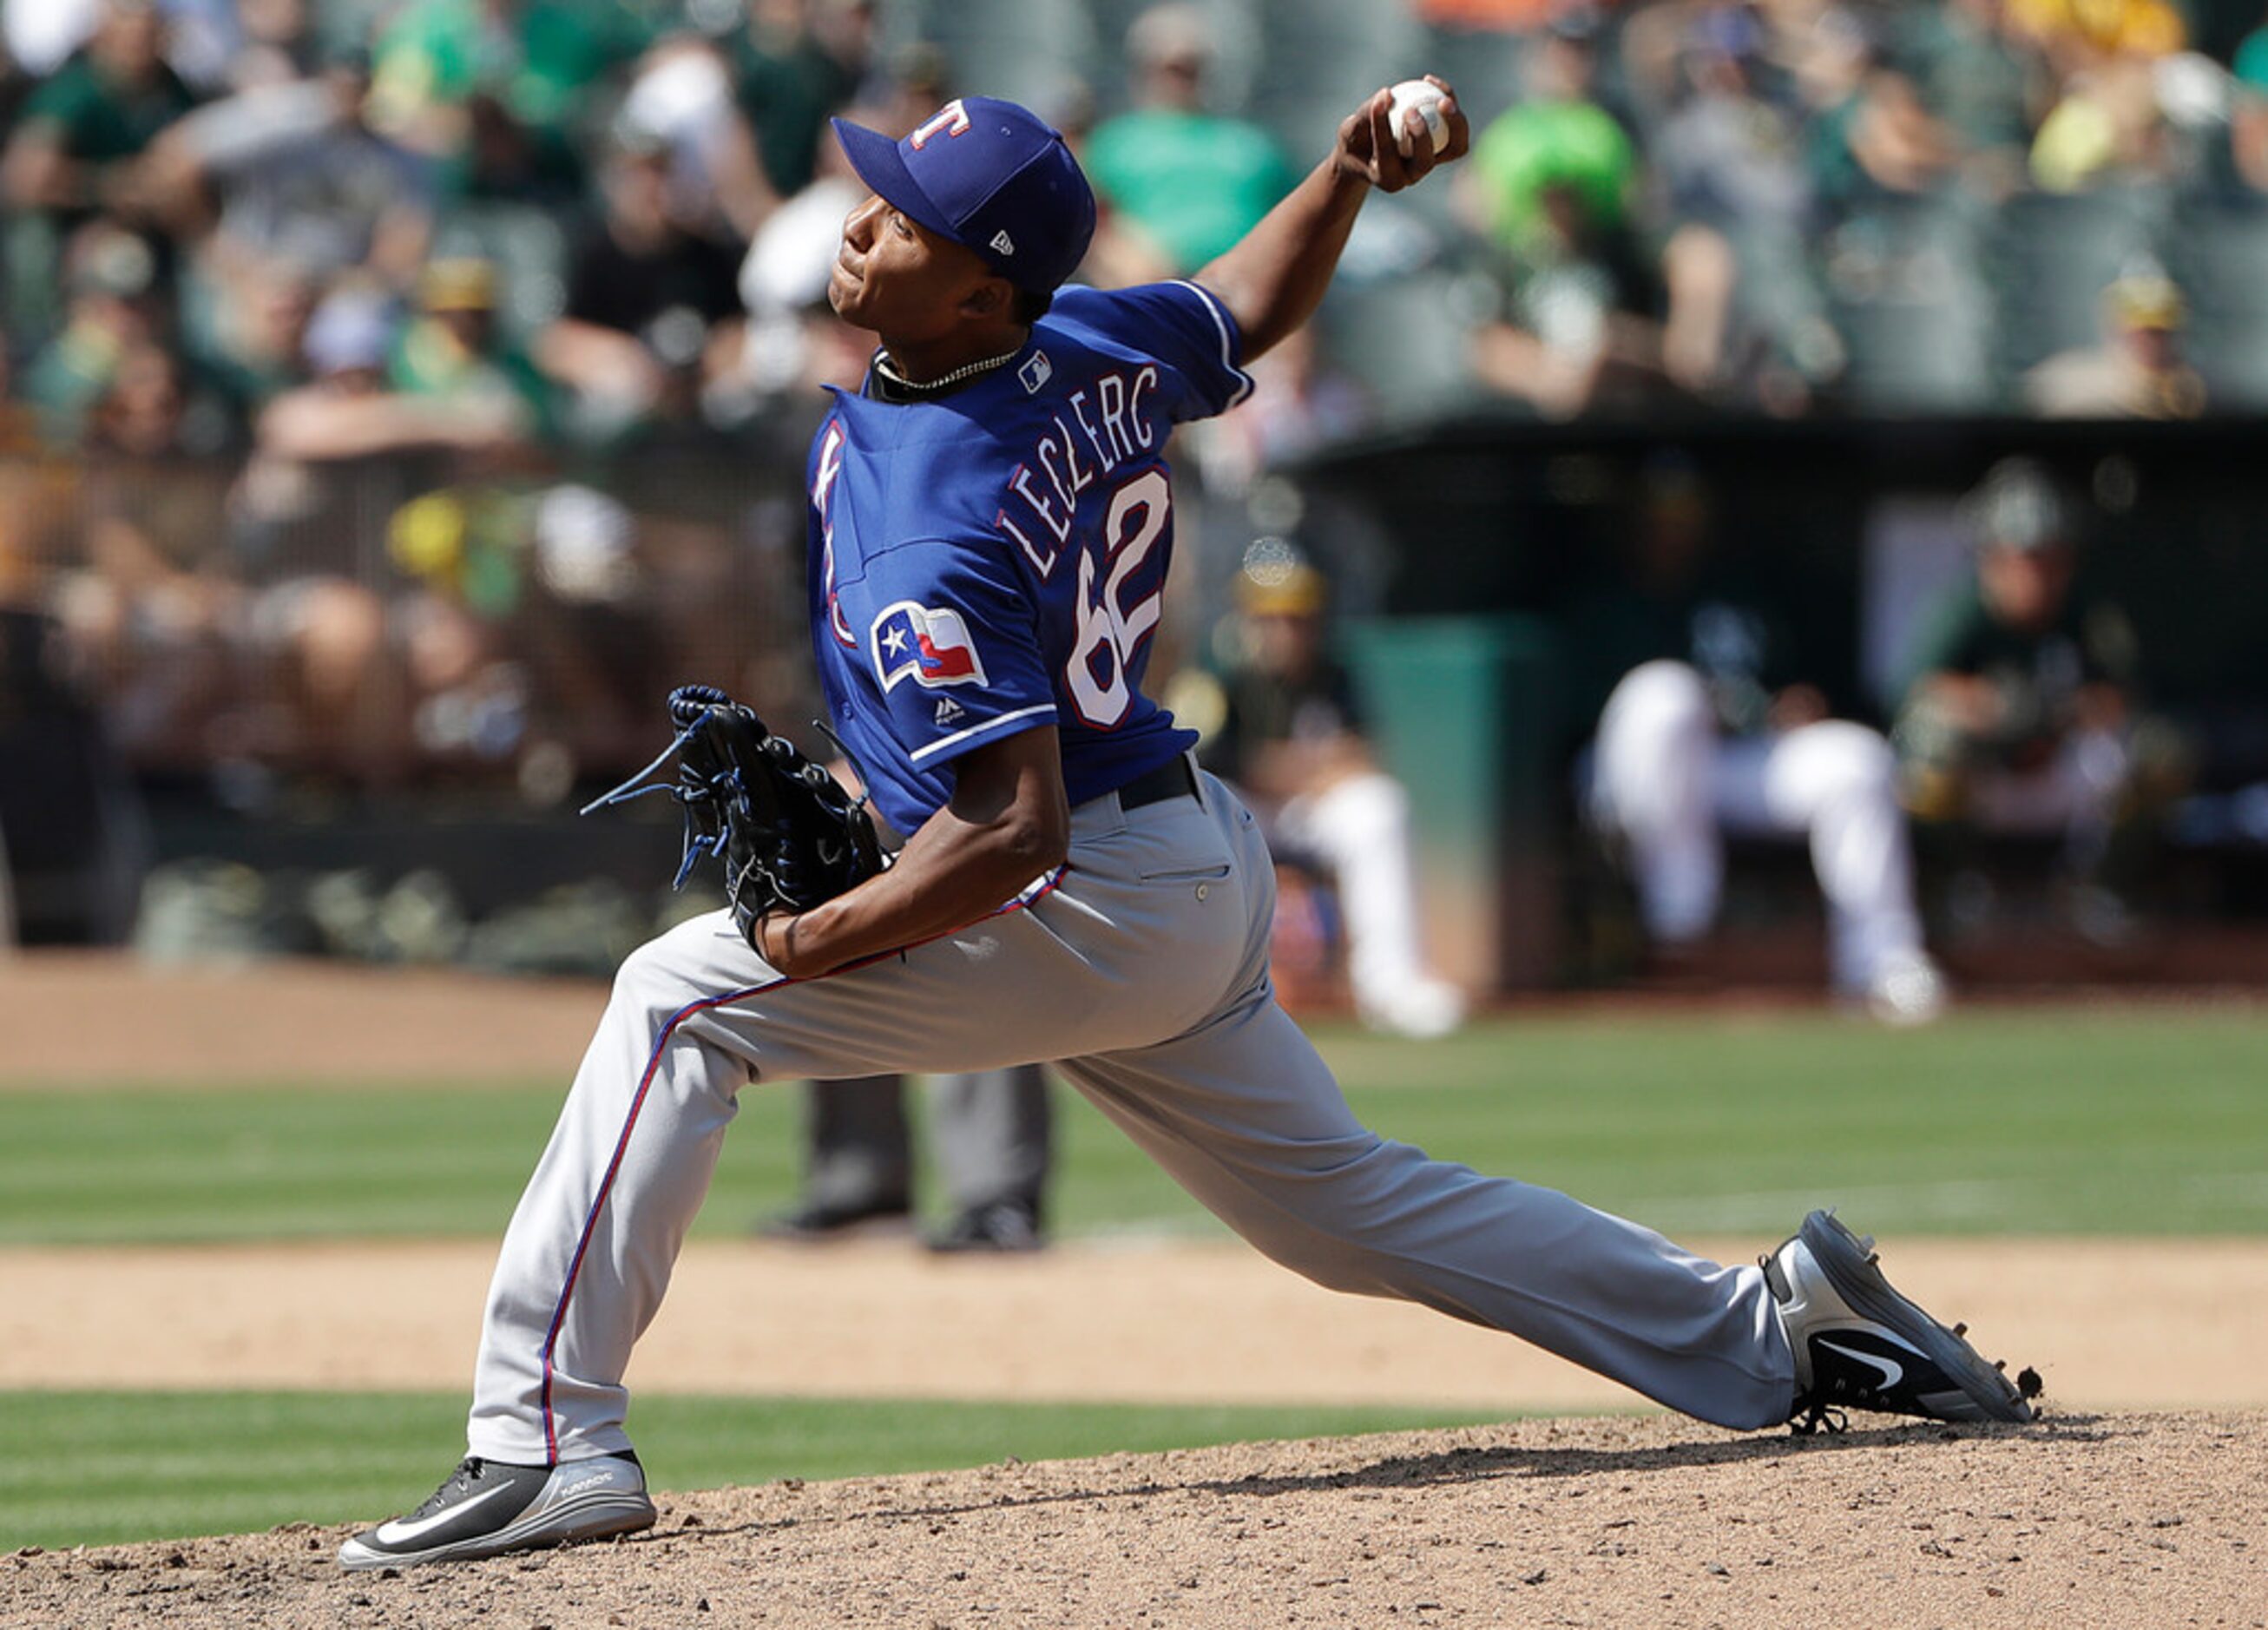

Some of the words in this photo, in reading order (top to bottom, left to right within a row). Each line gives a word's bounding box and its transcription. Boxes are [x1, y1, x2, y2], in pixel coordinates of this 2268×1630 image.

[909, 98, 971, 150] T
[996, 363, 1158, 581] LECLERC
[1064, 463, 1171, 731] 62
